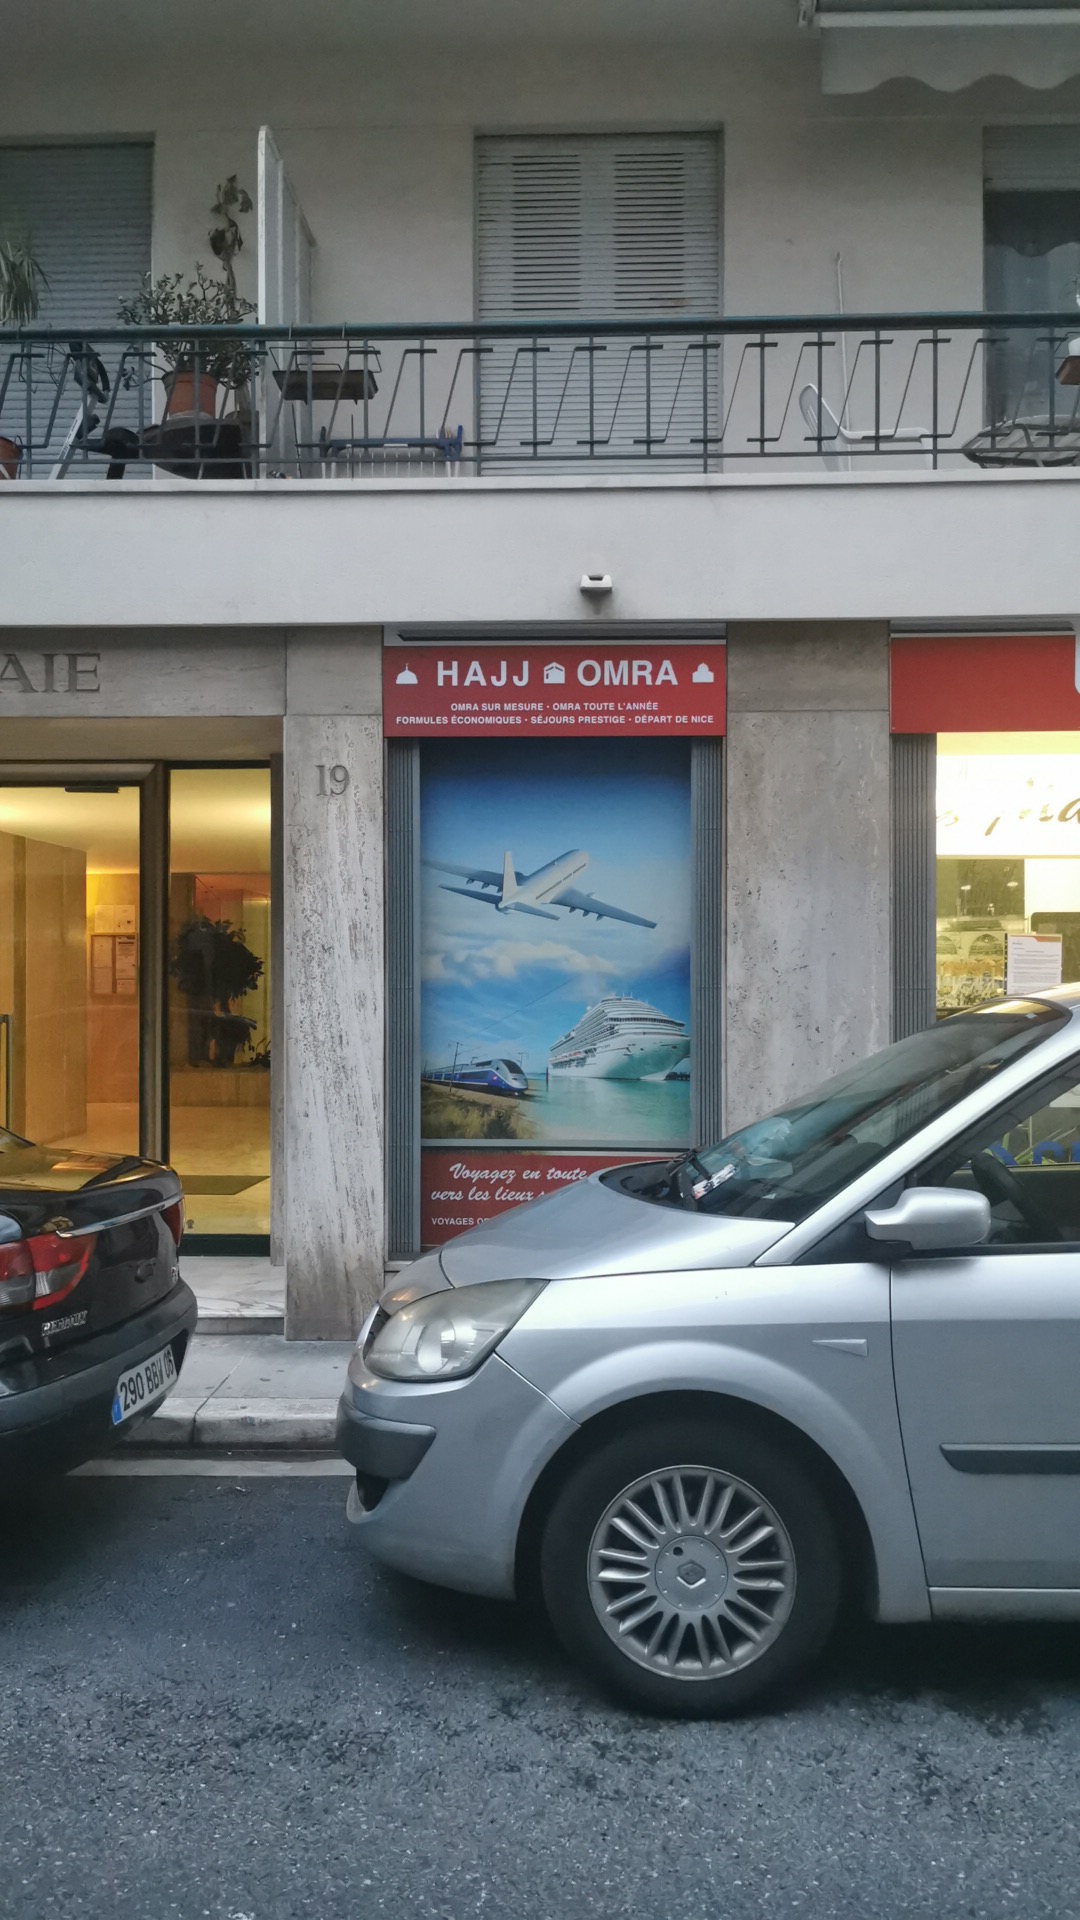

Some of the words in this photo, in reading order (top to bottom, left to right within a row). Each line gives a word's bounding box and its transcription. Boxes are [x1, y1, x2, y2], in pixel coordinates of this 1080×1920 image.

[436, 660, 530, 687] HAJJ
[576, 659, 679, 686] OMRA
[450, 702, 479, 711] OMRA
[481, 702, 501, 711] SUR
[503, 702, 544, 711] MESURE
[552, 702, 581, 711] OMRA
[583, 702, 615, 711] TOUTE
[617, 700, 659, 710] L'ANNÉE
[396, 716, 449, 725] FORMULES
[450, 714, 522, 725] ÉCONOMIQUES
[530, 714, 576, 725] SÉJOURS
[578, 715, 626, 724] PRESTIGE
[634, 713, 672, 724] DÉPART
[675, 715, 688, 724] DE
[691, 715, 714, 724] NICE
[315, 764, 350, 797] 19
[449, 1162, 517, 1185] Voyagez
[522, 1169, 542, 1180] en
[431, 1189, 464, 1201] vers
[467, 1186, 491, 1201] les
[494, 1187, 535, 1202] lieux
[431, 1217, 475, 1226] VOYAGES
[120, 1371, 145, 1412] 290
